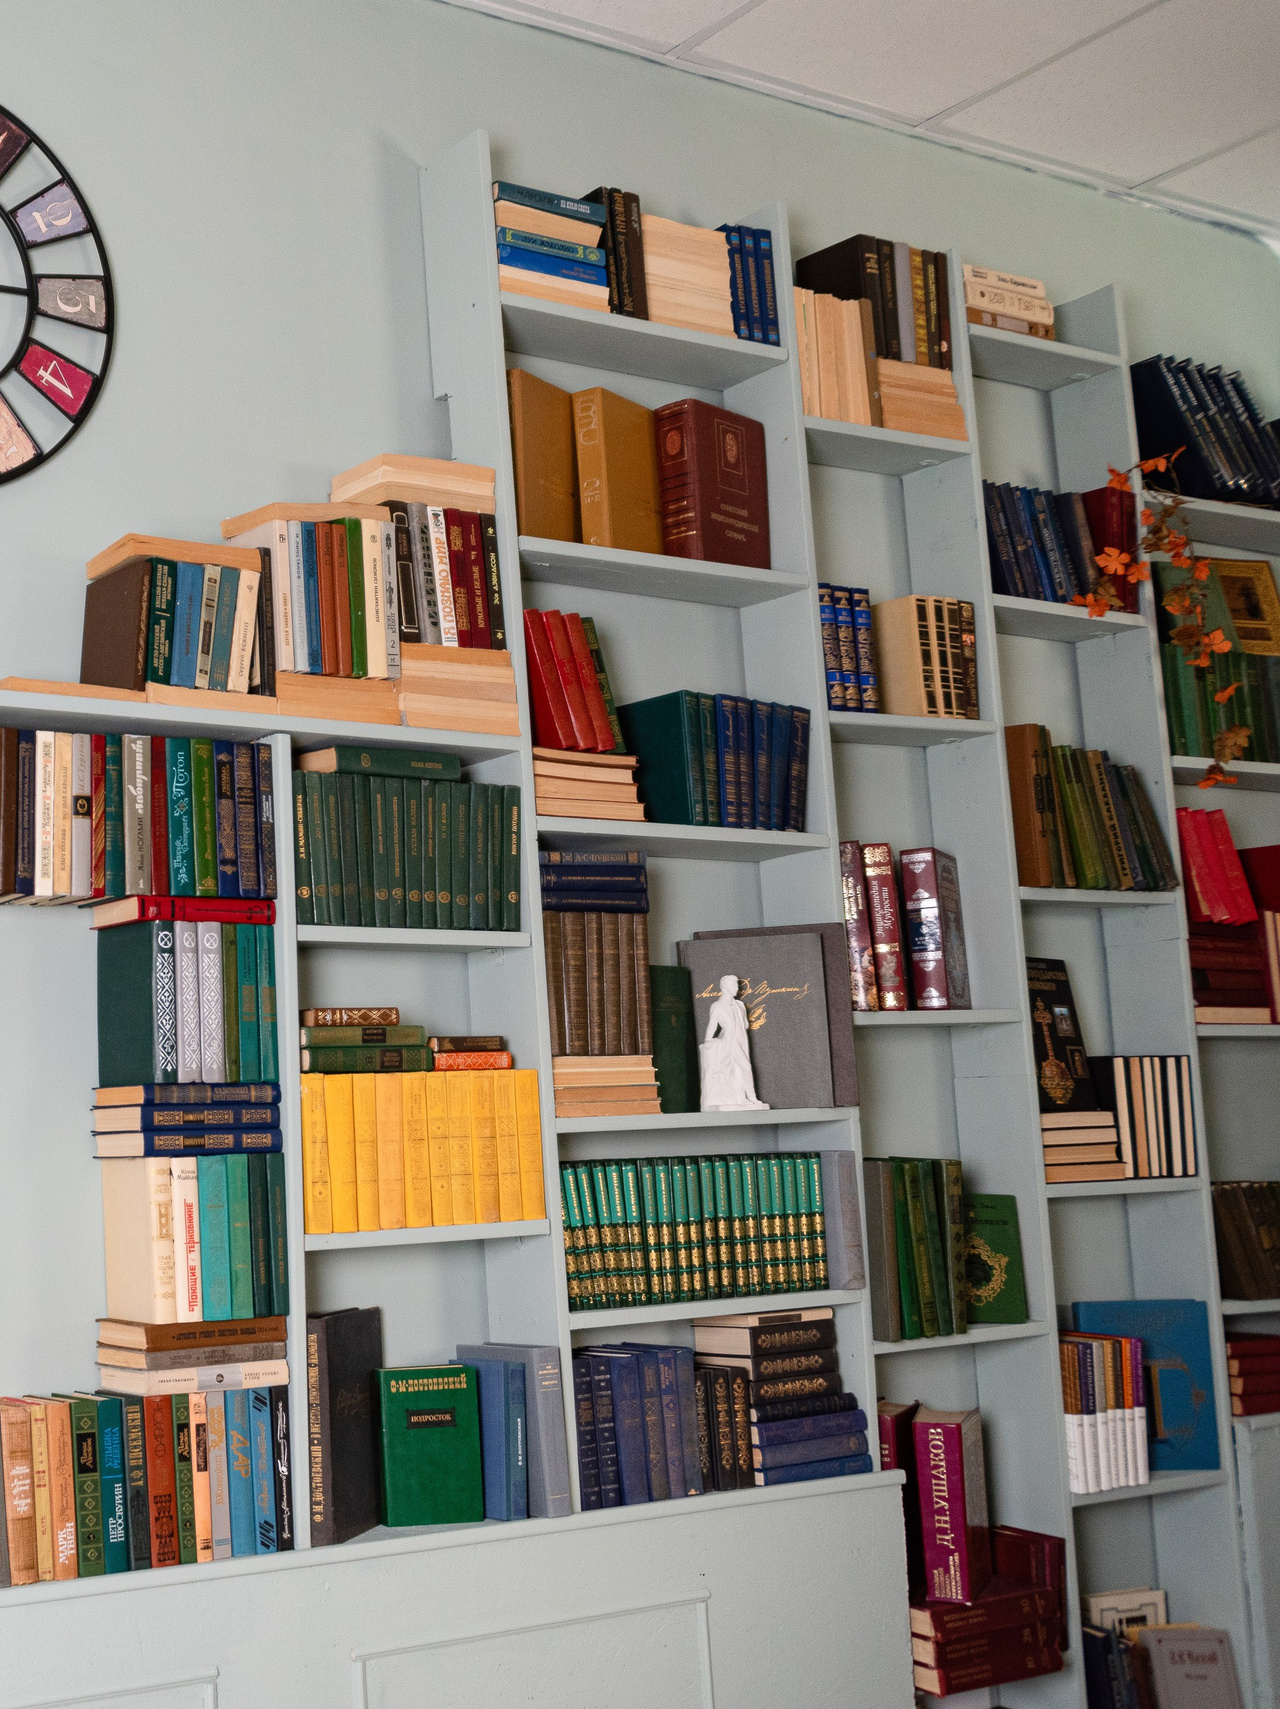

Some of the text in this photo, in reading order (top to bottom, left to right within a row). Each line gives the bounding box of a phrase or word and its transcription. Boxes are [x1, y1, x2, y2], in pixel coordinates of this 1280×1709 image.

[31, 201, 74, 235] 2
[56, 286, 98, 315] 3
[36, 361, 74, 399] 4
[435, 537, 456, 636] Я ПОЗНАЮ МИР
[472, 565, 480, 589] БЕЛЫЕ
[475, 596, 485, 628] КРАСНЫЕ
[241, 622, 249, 651] ЕСЕНИН
[173, 751, 190, 799] Потоп
[871, 880, 885, 937] Энциклопедия
[882, 887, 894, 929] Мудрости
[184, 1202, 200, 1311] ПОЮЩИЕ ТЕРНОВНИКЕ
[125, 1405, 143, 1466] ПИСЕМСКИЙ
[411, 1414, 451, 1422] ПОДРОСТОК
[103, 1427, 113, 1467] УЛЫБКА
[111, 1427, 120, 1468] РЕБЕНКА
[928, 1428, 955, 1549] Д.Н.УШАКОВ
[108, 1517, 117, 1542] ПЕТР
[114, 1483, 124, 1541] ПРОСКУРИН
[58, 1530, 68, 1564] МАРК
[66, 1522, 75, 1556] ТВЕН
